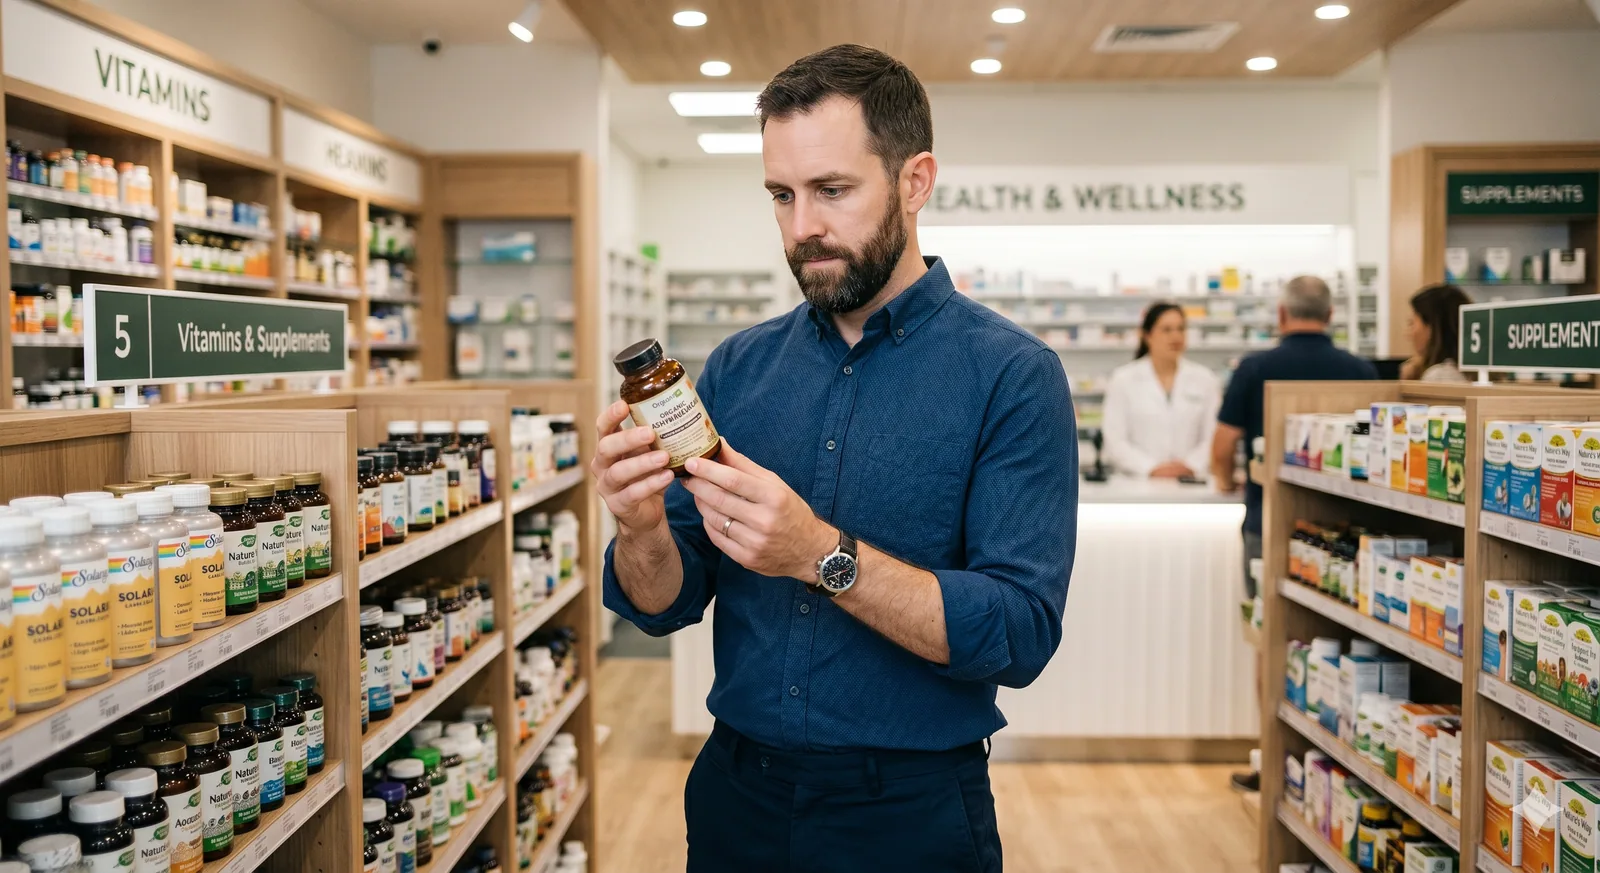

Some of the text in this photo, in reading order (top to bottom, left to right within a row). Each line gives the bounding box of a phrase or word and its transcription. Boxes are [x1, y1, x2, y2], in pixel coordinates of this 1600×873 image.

[94, 48, 211, 123] VITAMINS
[1044, 185, 1063, 212] &
[1076, 183, 1247, 212] WELLNESS
[1460, 185, 1584, 204] SUPPLEMENTS
[114, 314, 331, 359] 5 Vitamins & Supplements
[1470, 320, 1600, 354] 5 SUPPLEMENT
[659, 400, 687, 419] ORGANIC
[228, 551, 255, 561] Nature
[262, 541, 285, 551] Nature
[1563, 807, 1593, 837] Nature's Way
